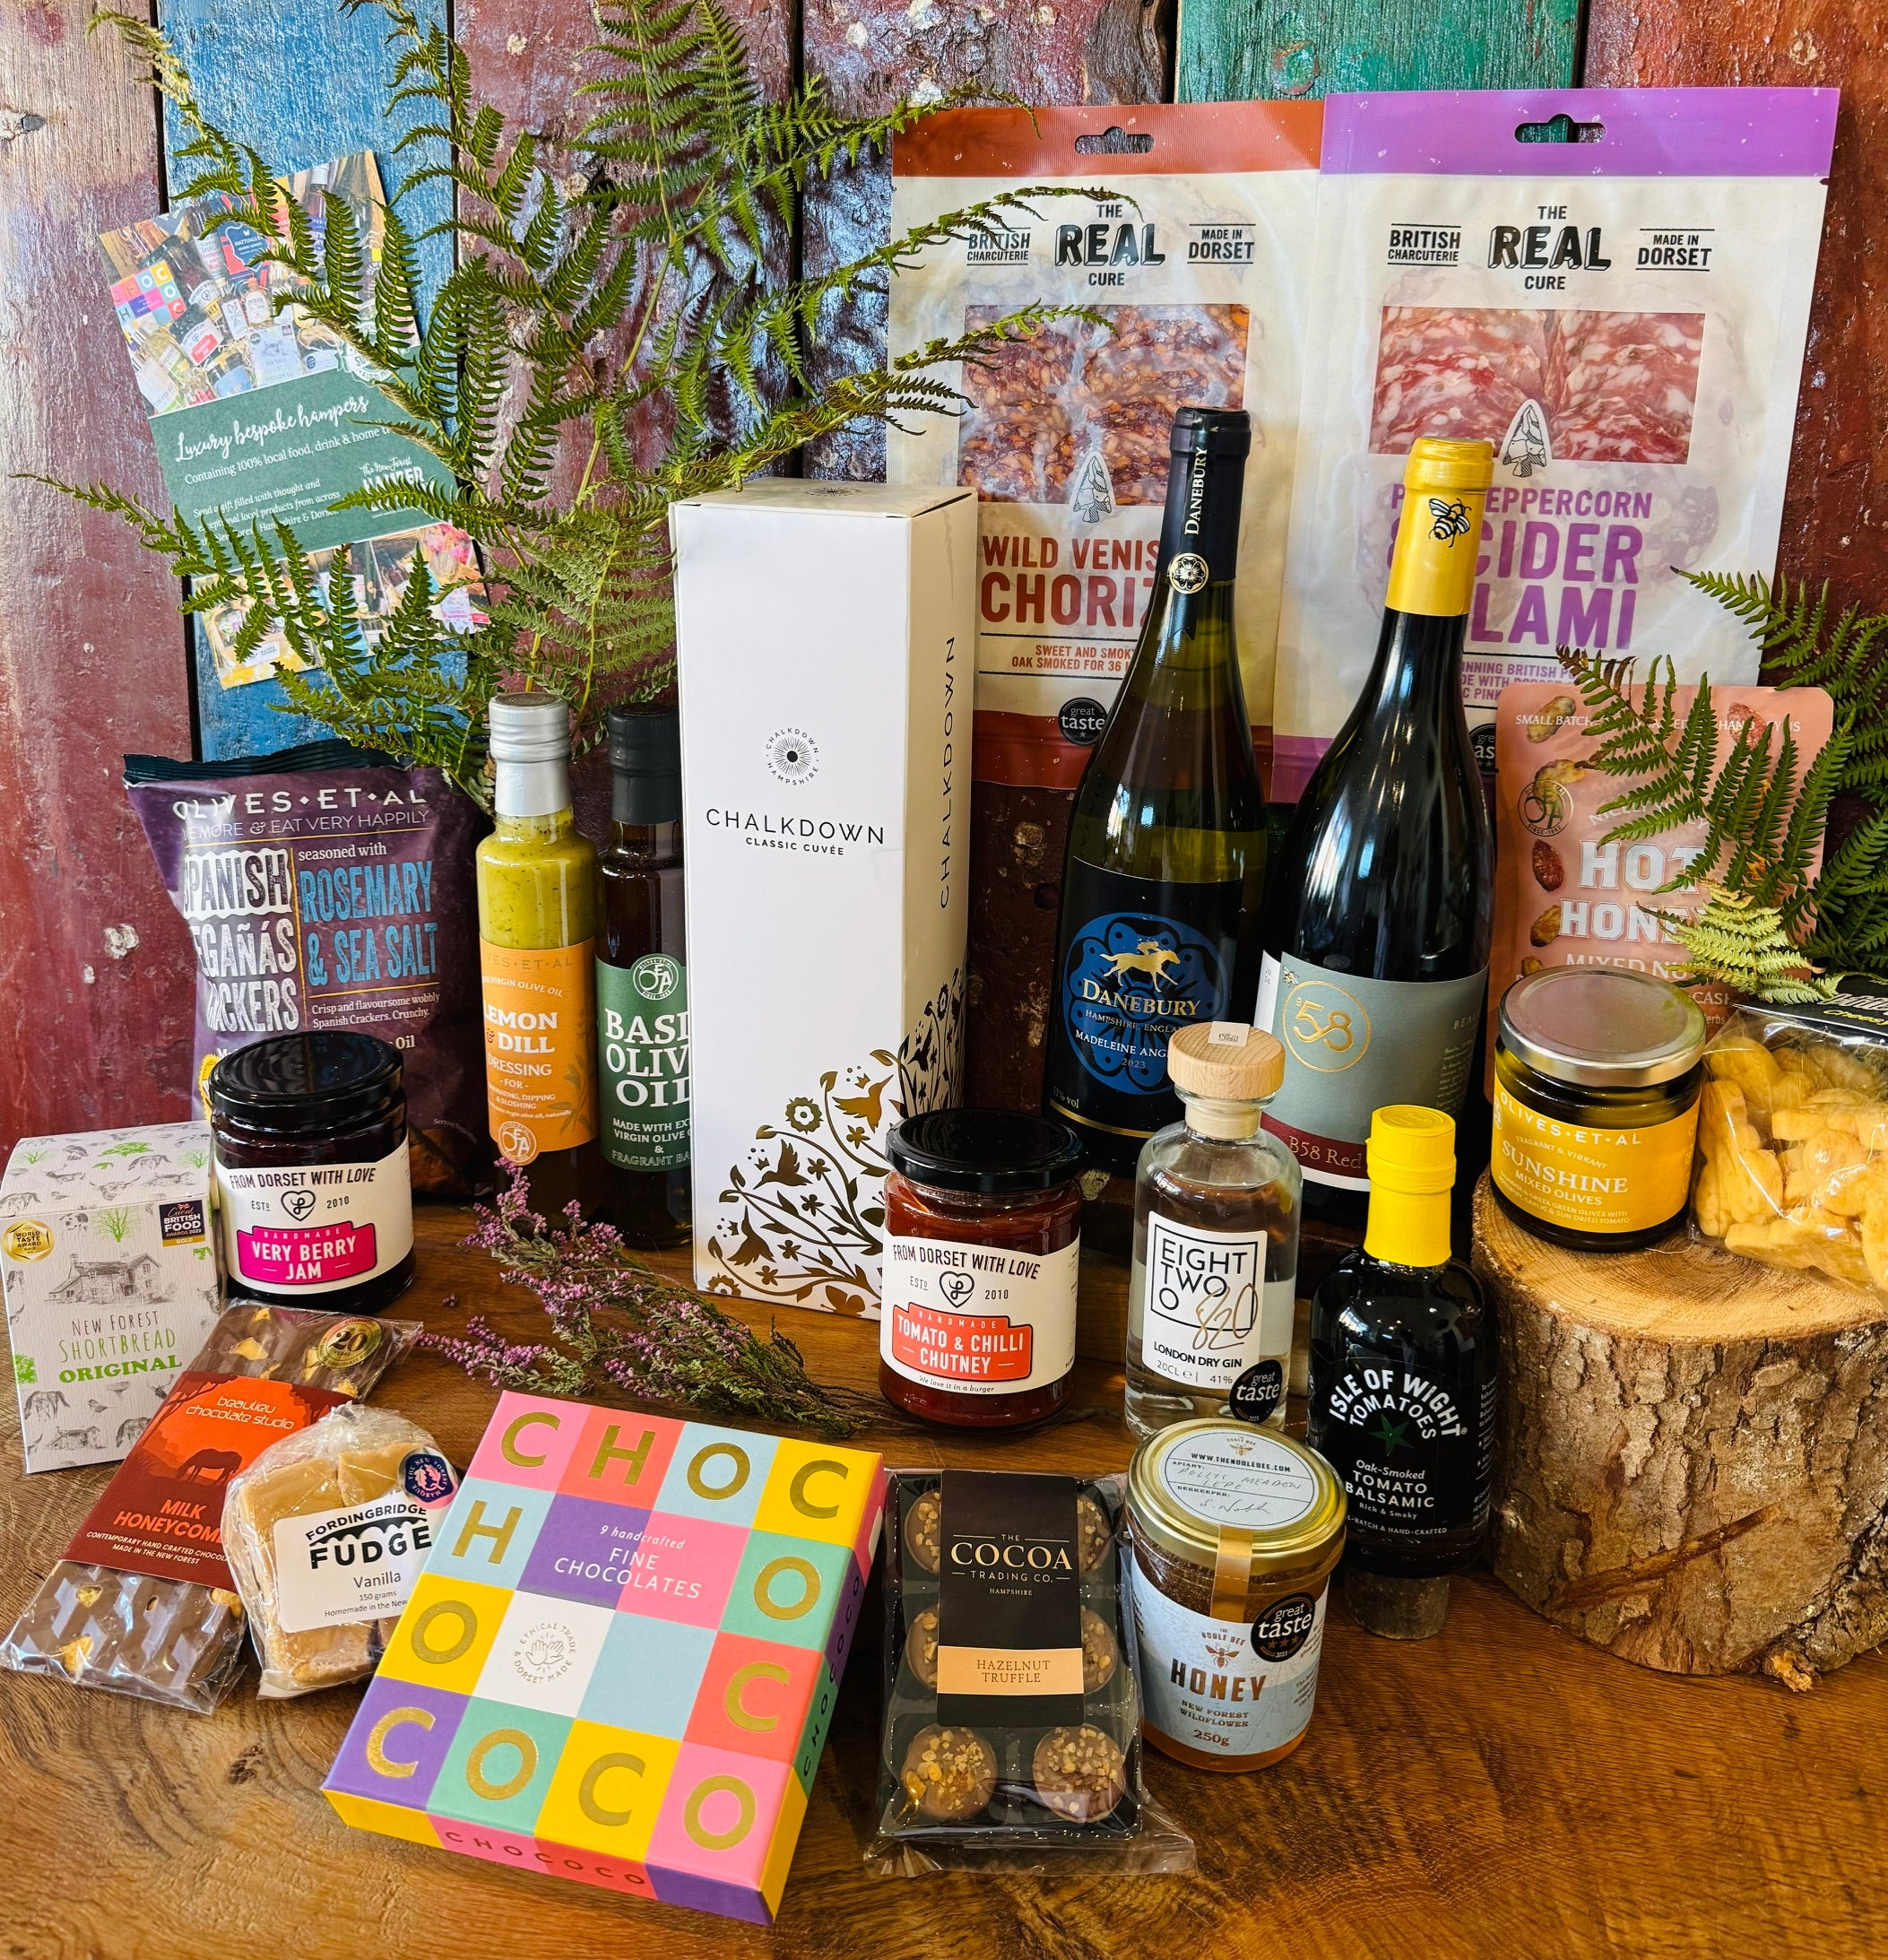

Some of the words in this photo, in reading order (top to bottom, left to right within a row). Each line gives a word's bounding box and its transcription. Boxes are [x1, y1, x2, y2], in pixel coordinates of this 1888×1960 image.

[1096, 204, 1122, 219] THE
[1537, 205, 1567, 221] THE
[1201, 229, 1229, 240] MADE
[1231, 230, 1243, 239] IN
[1390, 230, 1460, 249] BRITISH
[1652, 234, 1684, 247] MADE
[1687, 235, 1699, 246] IN
[966, 249, 1029, 262] CHARCUTERIE
[1054, 224, 1165, 267] REAL
[1188, 241, 1254, 260] DORSET
[1388, 248, 1459, 262] CHARCUTERIE
[1487, 225, 1611, 271] REAL
[1637, 247, 1712, 266] DORSET
[1087, 273, 1125, 287] CURE
[1524, 275, 1566, 291] CURE
[176, 431, 232, 462] Luxury
[234, 408, 296, 447] bespoke
[299, 395, 369, 427] hampers
[185, 464, 237, 484] Containing
[237, 458, 263, 472] 100%
[264, 449, 287, 464] local
[289, 445, 314, 458] food,
[316, 438, 341, 454] drink
[342, 435, 351, 445] &
[352, 429, 380, 442] home
[1184, 447, 1208, 535] DANEBURY
[1485, 483, 1652, 518] EPPERCORN
[983, 535, 1059, 568] WILD
[1072, 538, 1160, 572] VENIS
[1470, 583, 1636, 649] LAMI
[1035, 645, 1072, 657] SWEET
[1075, 646, 1096, 658] AND
[1011, 656, 1033, 668] OAK
[1036, 657, 1080, 670] SMOKED
[1084, 659, 1104, 671] FOR
[1108, 660, 1122, 672] 36
[1070, 707, 1095, 717] great
[1515, 715, 1552, 725] SMALL
[1556, 716, 1592, 726] BATCH
[765, 727, 819, 754] CHALKDOWN
[940, 637, 955, 909] CHALKDOWN
[199, 822, 244, 839] MORE
[250, 821, 266, 835] &
[271, 819, 303, 834] EAT
[307, 815, 354, 832] VERY
[359, 810, 429, 828] HAPPILY
[706, 808, 884, 845] CHALKDOWN
[299, 846, 356, 862] seasoned
[358, 842, 387, 856] with
[746, 837, 797, 850] CLASSIC
[802, 843, 844, 855] CUVÉE
[299, 861, 434, 924] ROSEMARY
[307, 932, 328, 986] &
[335, 929, 380, 984] SEA
[385, 923, 438, 980] SALT
[312, 1005, 336, 1016] Crisp
[338, 1001, 354, 1011] and
[356, 996, 411, 1010] flavoursome
[411, 992, 440, 1004] wobbly
[1082, 978, 1200, 1017] DANEBURY
[313, 1016, 349, 1029] Spanish
[350, 1013, 391, 1025] Crackers.
[393, 1008, 430, 1020] Crunchy.
[395, 1035, 416, 1050] Oil
[1076, 1029, 1137, 1054] MADELEINE
[1122, 1058, 1146, 1070] 2023
[613, 1118, 640, 1132] MADE
[643, 1123, 672, 1133] WITH
[614, 1130, 650, 1143] VIRGIN
[652, 1130, 685, 1143] OLIVE
[1503, 1140, 1629, 1193] SUNSHINE
[230, 1174, 255, 1190] FROM
[258, 1173, 307, 1188] DORSET
[311, 1170, 343, 1185] WITH
[347, 1168, 377, 1184] LOVE
[1515, 1170, 1551, 1195] MIXED
[1554, 1188, 1603, 1206] OLIVES
[326, 1196, 350, 1210] 2010
[163, 1213, 201, 1224] BRITISH
[164, 1220, 201, 1232] FOOD
[264, 1227, 341, 1240] HANDMADE
[252, 1240, 291, 1262] VERY
[299, 1236, 357, 1262] BERRY
[1162, 1237, 1248, 1275] EIGHT
[286, 1262, 322, 1280] JAM
[893, 1245, 917, 1262] FROM
[919, 1247, 967, 1268] DORSET
[972, 1253, 1005, 1273] WITH
[1009, 1259, 1040, 1279] LOVE
[1160, 1261, 1227, 1297] TWO
[985, 1289, 1009, 1300] 2010
[72, 1318, 101, 1336] NEW
[110, 1310, 159, 1331] FOREST
[897, 1314, 947, 1348] TOMATO
[954, 1336, 964, 1351] &
[971, 1332, 1024, 1352] CHILLI
[58, 1328, 176, 1364] SHORTBREAD
[1154, 1341, 1196, 1365] LONDON
[1198, 1356, 1220, 1367] DRY
[1222, 1358, 1243, 1368] GIN
[58, 1354, 183, 1384] ORIGINAL
[920, 1348, 992, 1375] CHUTNEY
[1251, 1372, 1276, 1386] great
[1236, 1383, 1280, 1401] taste
[1329, 1375, 1363, 1421] ISLE
[1364, 1369, 1394, 1390] OF
[1403, 1373, 1461, 1436] WIGHT
[216, 1395, 276, 1414] beaulieu
[186, 1404, 252, 1423] chocolate
[253, 1415, 295, 1430] studio
[1349, 1394, 1437, 1439] TOMATOES
[1191, 1453, 1291, 1472] WWW.THENOBLEBEE.COM
[1356, 1460, 1425, 1479] Oak-Smoked
[1353, 1470, 1427, 1494] TOMATO
[1346, 1481, 1434, 1508] BALSAMIC
[160, 1499, 208, 1519] MILK
[114, 1511, 222, 1543] HONEYCOM
[306, 1504, 427, 1541] FORDINGBRIDGE
[309, 1525, 432, 1569] FUDGE
[1001, 1533, 1020, 1541] THE
[112, 1544, 133, 1553] MADE
[173, 1555, 200, 1565] FOREST
[608, 1547, 659, 1571] FINE
[950, 1542, 1073, 1570] COCOA
[353, 1571, 402, 1588] Vanilla
[553, 1557, 703, 1599] CHOCOLATES
[970, 1570, 1028, 1582] TRADING
[1034, 1574, 1053, 1583] CO.
[359, 1593, 373, 1601] 150
[374, 1591, 397, 1601] grams
[989, 1588, 1033, 1596] HAMPSHIRE
[1275, 1603, 1305, 1622] great
[1258, 1613, 1312, 1639] taste
[977, 1659, 1051, 1671] HAZELNUT
[982, 1672, 1041, 1683] TRUFFLE
[1170, 1658, 1267, 1702] HONEY
[1180, 1708, 1249, 1728] WILDFLOWER
[1182, 1700, 1203, 1712] NEW
[1207, 1709, 1250, 1719] FOREST
[1193, 1729, 1230, 1747] 250g
[444, 1831, 645, 1886] CHOCOCO
